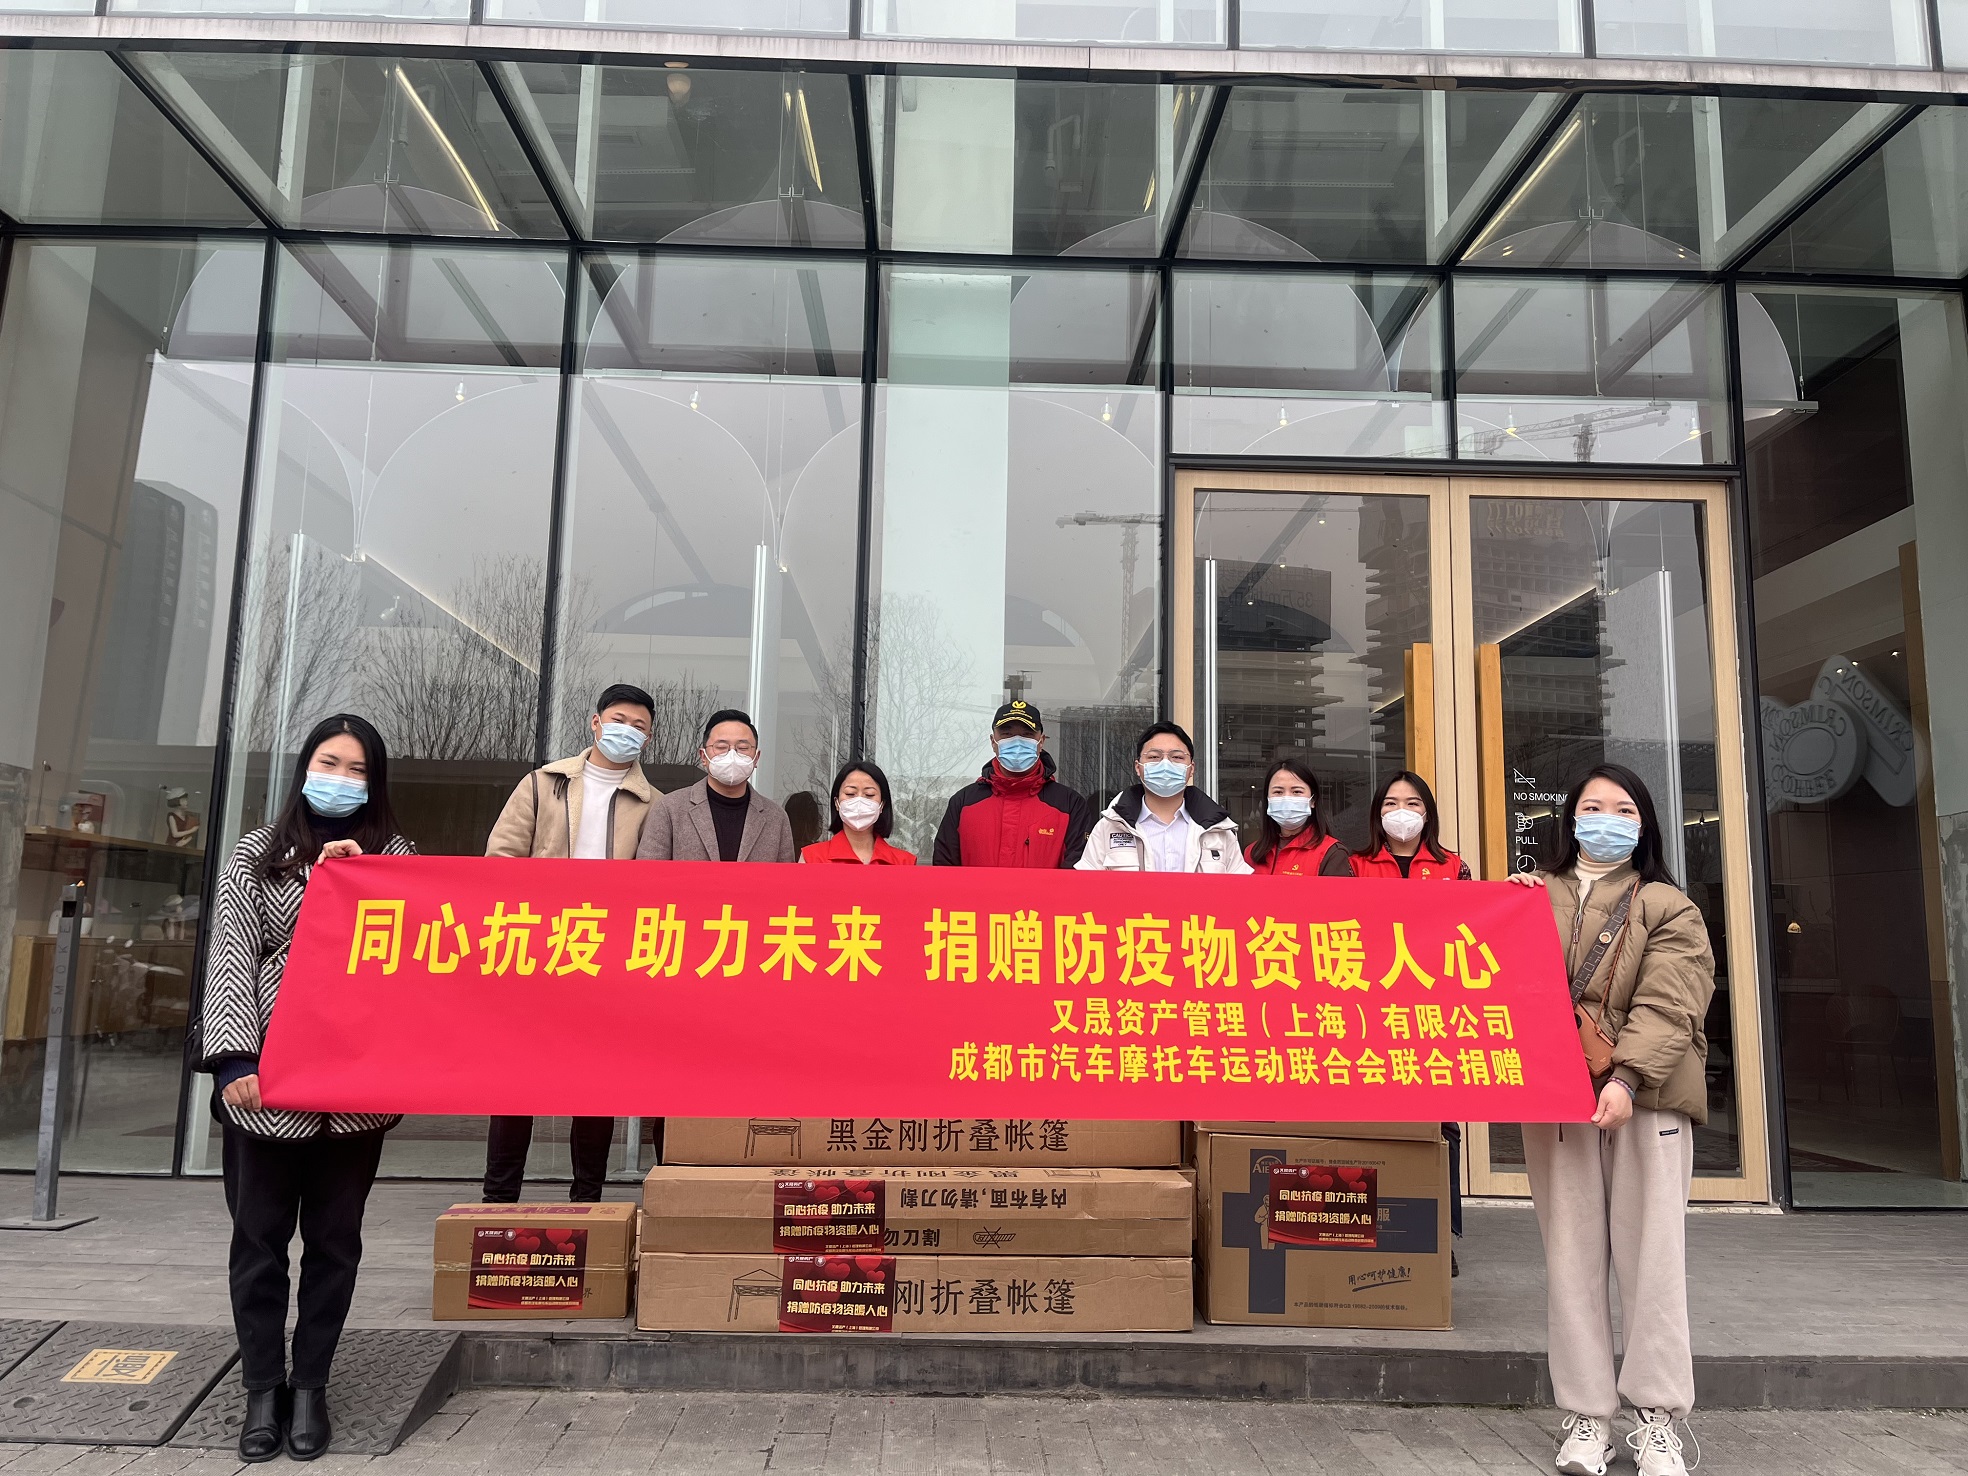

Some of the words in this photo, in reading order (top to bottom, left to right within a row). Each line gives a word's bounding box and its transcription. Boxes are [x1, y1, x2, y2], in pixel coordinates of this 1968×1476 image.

[1513, 792, 1527, 801] NO
[1515, 836, 1538, 845] PULL
[347, 899, 609, 977] 同心抗疫
[626, 904, 883, 982] 助力未来
[924, 907, 1501, 992] 捐赠防疫物资暖人心
[948, 1040, 1525, 1087] 成都市汽车摩托车运动联合会联合捐赠
[827, 1118, 1070, 1153] 黑金刚折叠帐篷
[1280, 1189, 1322, 1202] 同心抗疫
[1325, 1191, 1368, 1203] 助力未来
[784, 1203, 829, 1216] 同心抗疫
[831, 1203, 876, 1215] 助力未来
[1274, 1210, 1372, 1225] 捐赠防疫物资暖人心
[780, 1224, 879, 1237] 捐赠防疫物资暖人心
[481, 1252, 528, 1265] 同心抗疫
[530, 1253, 576, 1266] 助力未来
[475, 1275, 579, 1288] 捐赠防疫物资暖人心
[792, 1279, 838, 1292] 同心抗疫
[840, 1281, 885, 1295] 助力未来
[786, 1301, 888, 1317] 捐赠防疫物资暖人心
